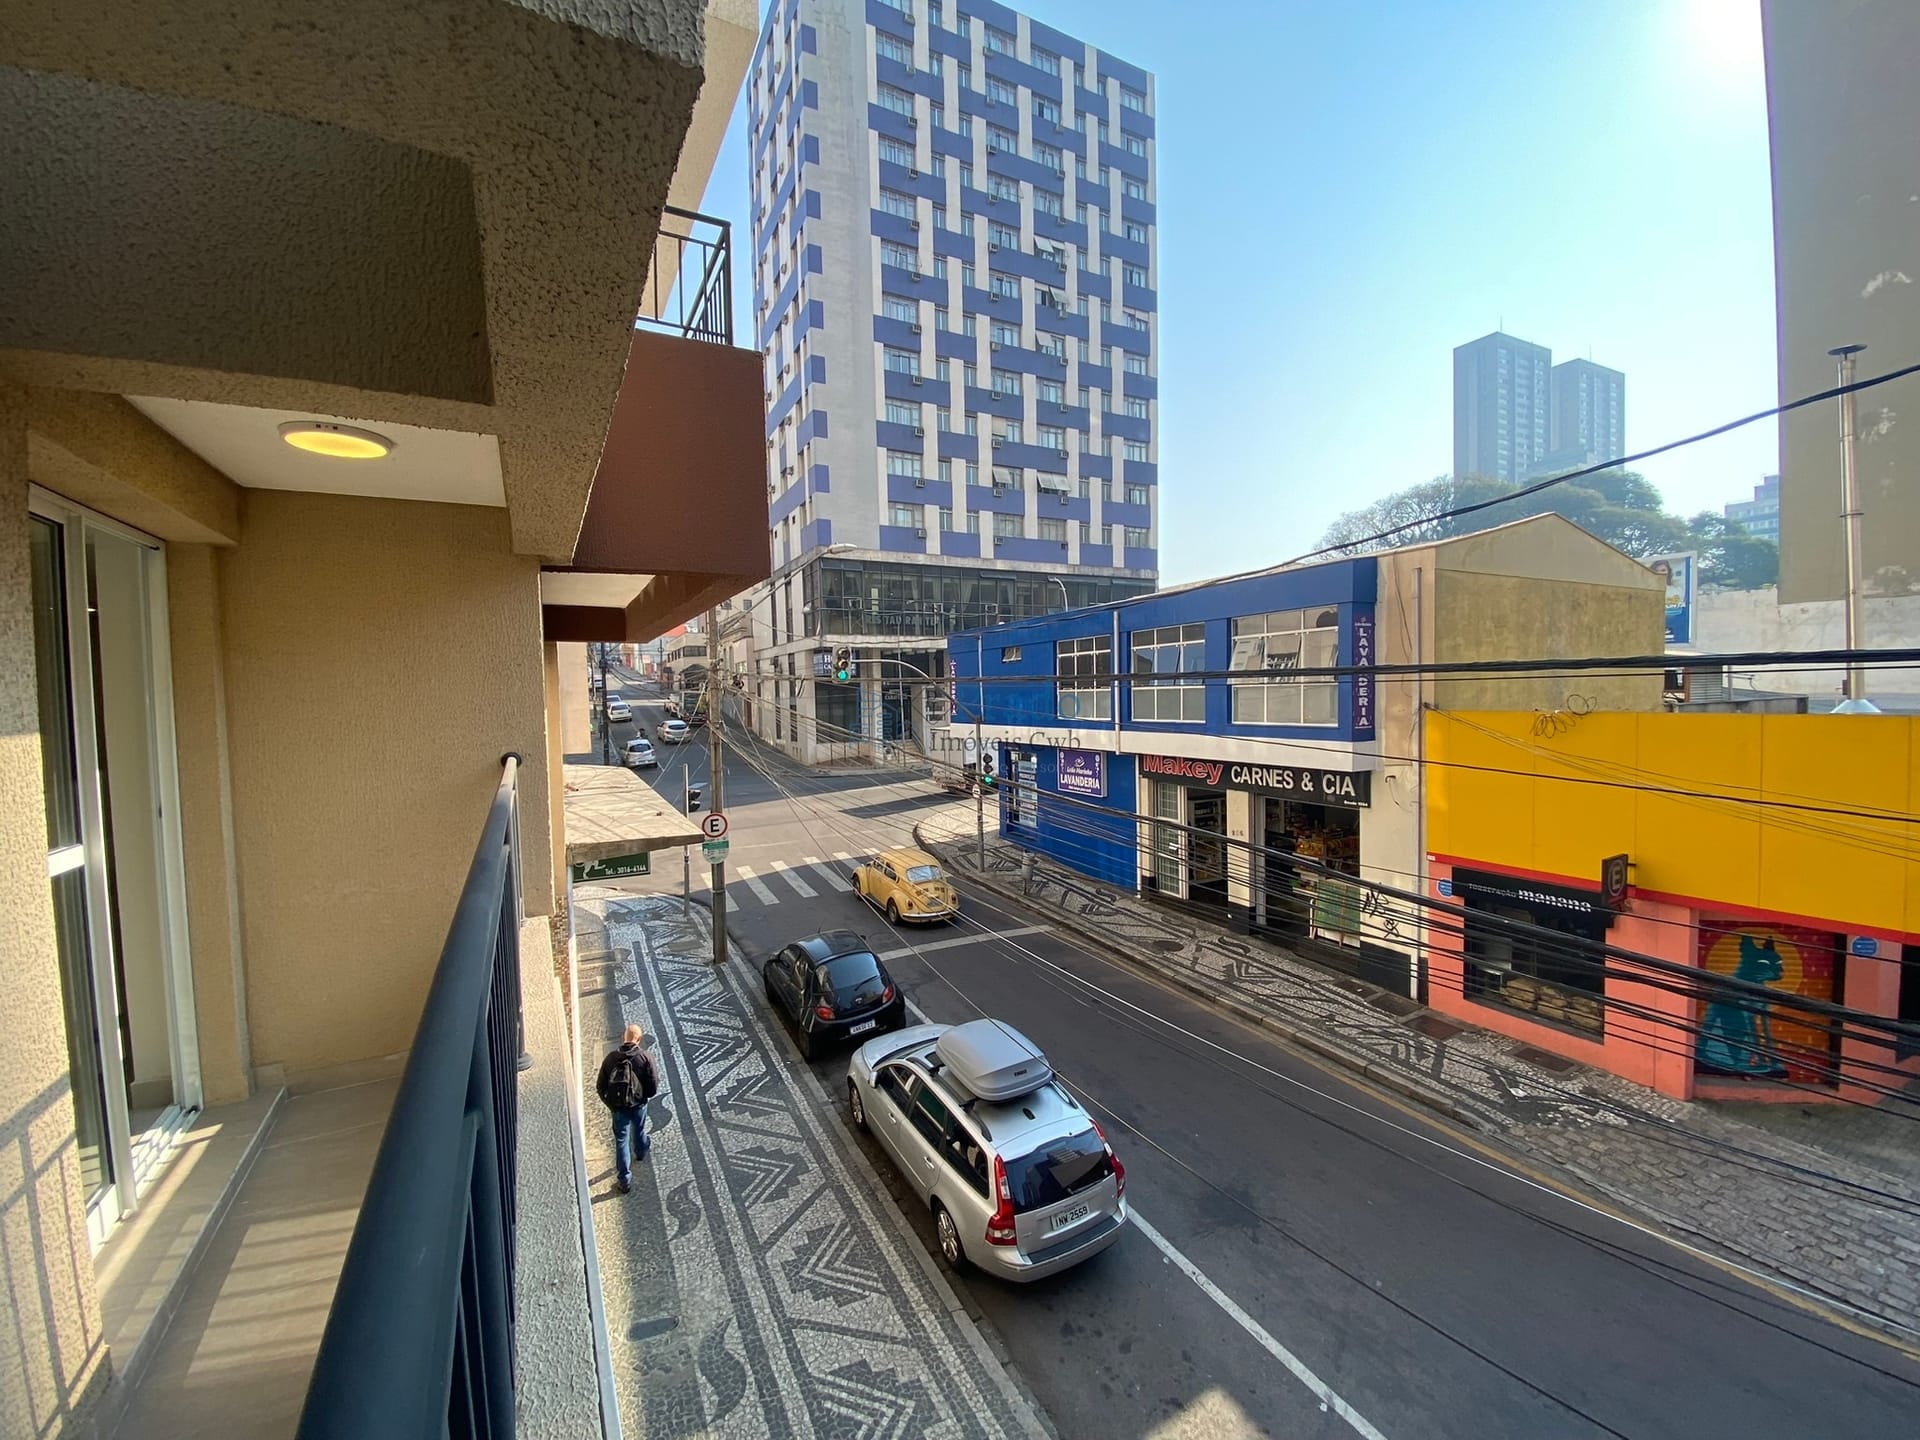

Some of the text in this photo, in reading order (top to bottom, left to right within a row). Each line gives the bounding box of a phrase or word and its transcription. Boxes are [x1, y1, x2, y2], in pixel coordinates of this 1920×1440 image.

[1358, 627, 1369, 726] LAVADERIA
[1060, 773, 1100, 790] LAVANDERIA
[1143, 754, 1356, 797] Makey CARNES & CIA
[710, 818, 720, 833] E
[1612, 866, 1621, 890] E
[1069, 1206, 1089, 1221] 2559
